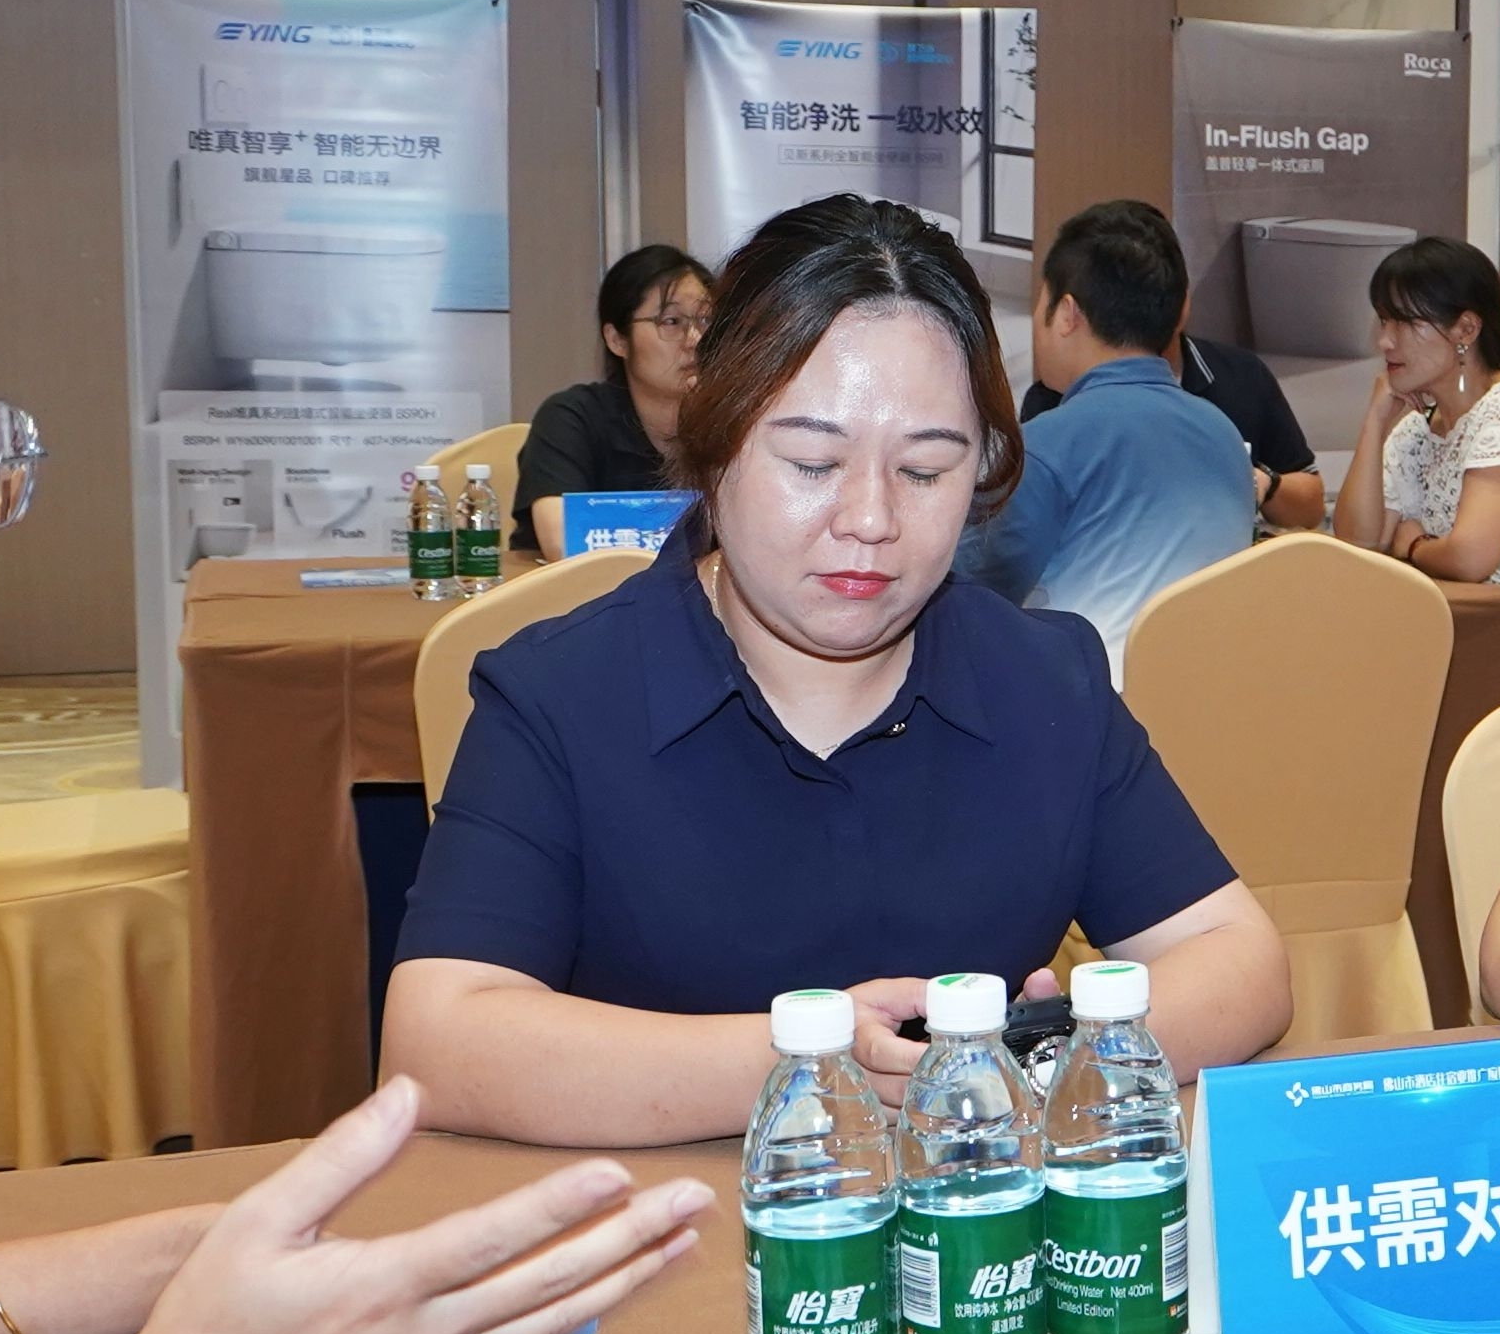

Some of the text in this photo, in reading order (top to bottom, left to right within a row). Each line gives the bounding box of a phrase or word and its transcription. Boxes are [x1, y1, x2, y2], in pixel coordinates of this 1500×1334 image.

[1404, 53, 1451, 70] Roca
[740, 100, 985, 136] 智能净洗 一级水效
[314, 134, 442, 159] 智能无边界
[1205, 123, 1369, 155] In-Flush Gap
[332, 529, 366, 539] Flush
[969, 1254, 1036, 1299] 怡寶
[1054, 1277, 1153, 1299] Drinking Water Net 400ml
[786, 1284, 865, 1324] 怡寶
[955, 1302, 998, 1318] 饮用纯净水
[1057, 1297, 1114, 1317] Limited Edition
[992, 1315, 1024, 1334] 渠道限定
